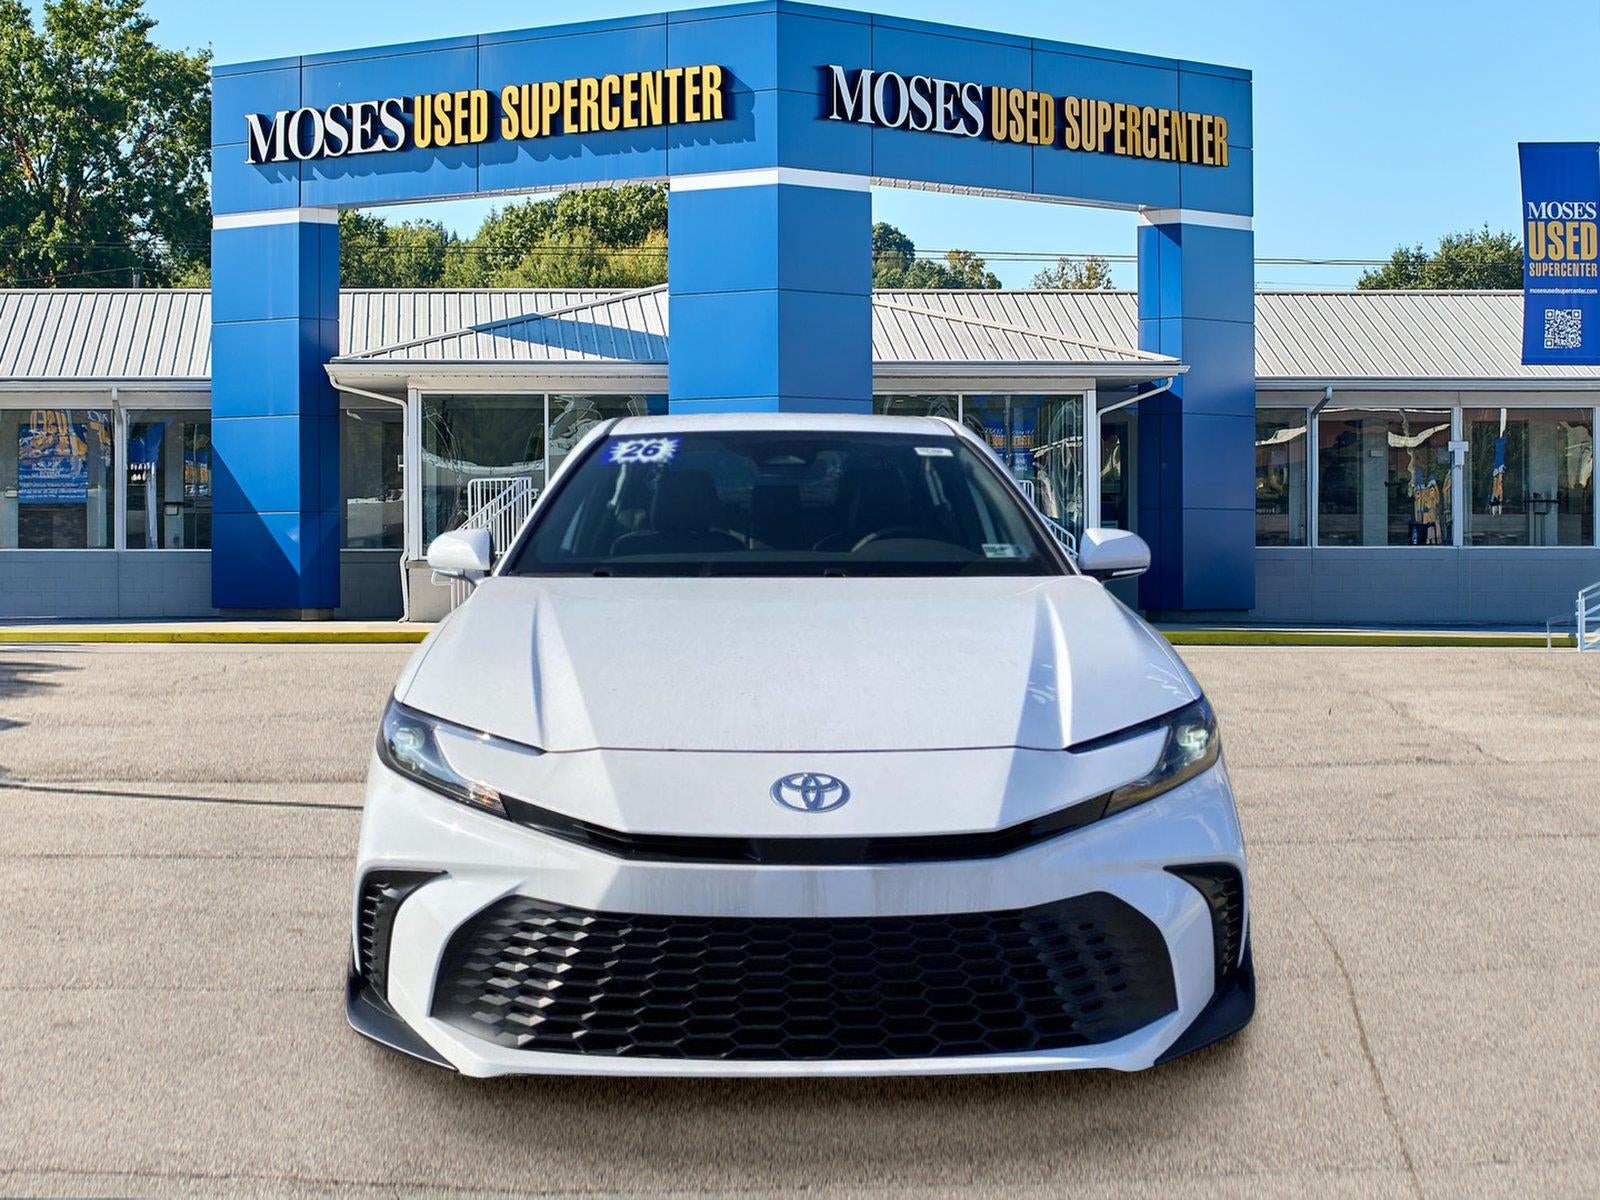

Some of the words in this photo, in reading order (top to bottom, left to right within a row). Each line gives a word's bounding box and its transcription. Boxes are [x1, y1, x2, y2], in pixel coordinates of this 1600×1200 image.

[245, 97, 406, 164] MOSES
[413, 88, 488, 149] USED
[501, 64, 723, 141] SUPERCENTER
[829, 64, 984, 138] MOSES
[991, 86, 1055, 145] USED
[1064, 96, 1229, 167] SUPERCENTER
[1527, 201, 1597, 220] MOSES
[1528, 220, 1598, 261] USED
[1529, 262, 1598, 277] SUPERCENTER
[621, 442, 663, 458] 26
